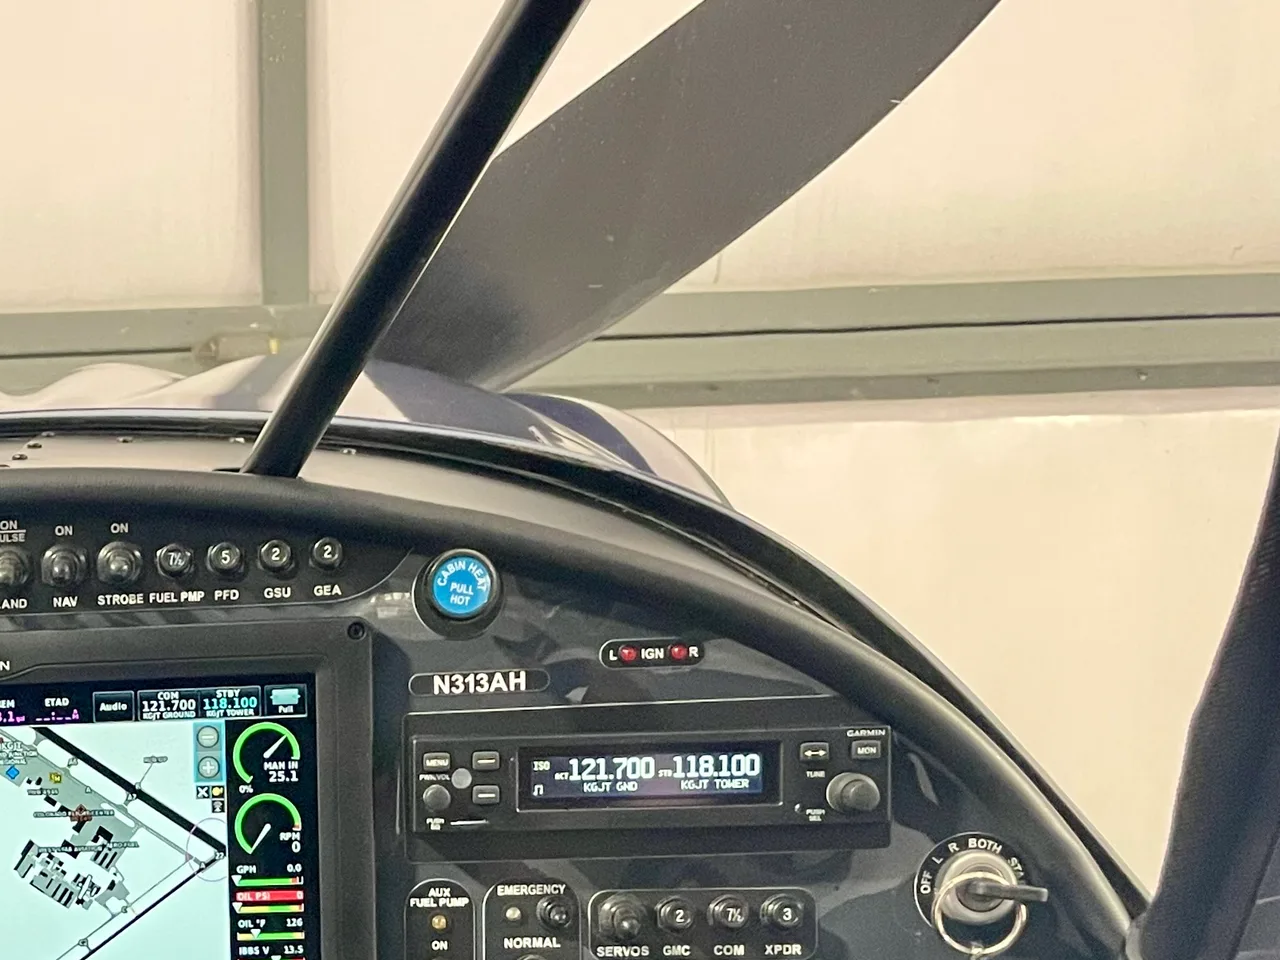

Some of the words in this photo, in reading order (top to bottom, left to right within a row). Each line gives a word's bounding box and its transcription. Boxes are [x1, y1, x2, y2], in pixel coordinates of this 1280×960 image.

[0, 520, 18, 530] ON
[55, 526, 73, 536] ON
[110, 523, 128, 534] ON
[221, 551, 230, 564] 5
[272, 548, 280, 560] 2
[324, 545, 332, 558] 2
[436, 560, 465, 586] CABIN
[468, 561, 488, 592] HEAT
[214, 589, 239, 601] PFD
[264, 587, 291, 599] GSU
[314, 584, 342, 596] GEA
[450, 582, 474, 596] PULL
[53, 596, 78, 608] NAV
[97, 593, 144, 606] STROBE
[149, 592, 178, 604] FUEL
[180, 590, 205, 602] PMP
[450, 595, 470, 606] HOT
[609, 650, 617, 660] L
[641, 648, 664, 660] IGN
[689, 646, 699, 658] R
[432, 671, 526, 695] N313AH
[158, 692, 179, 700] COM
[216, 689, 240, 698] STBY
[44, 698, 69, 707] ETAD
[100, 703, 128, 713] Audio
[142, 699, 196, 712] 121.700
[203, 697, 257, 710] 118.100
[226, 708, 254, 717] TOWER
[846, 729, 886, 738] GARMIN
[857, 746, 876, 755] MON
[264, 761, 285, 770] MAN
[533, 761, 550, 772] ISO
[569, 756, 655, 781] 121.700
[672, 754, 760, 778] 118.100
[269, 770, 298, 782] 25.1
[584, 782, 612, 793] KGJT
[616, 782, 638, 792] GND
[681, 779, 708, 790] KGJT
[714, 778, 750, 789] TOWER
[280, 832, 300, 841] RPM
[292, 842, 301, 853] 0
[948, 842, 959, 853] R
[968, 838, 1002, 854] BOTH
[932, 856, 944, 864] L
[236, 865, 256, 874] GPH
[286, 864, 302, 873] 0.0
[920, 870, 932, 894] OFF
[428, 887, 450, 898] AUX
[497, 884, 566, 896] EMERGENCY
[410, 898, 437, 908] FUEL
[439, 897, 470, 908] PUMP
[676, 910, 684, 922] 2
[782, 907, 792, 920] 3
[238, 920, 254, 928] OIL
[432, 940, 448, 951] ON
[504, 937, 560, 948] NORMAL
[596, 946, 650, 958] SERVOS
[663, 944, 690, 956] GMC
[714, 944, 744, 956] COM
[764, 944, 802, 956] XPDR
